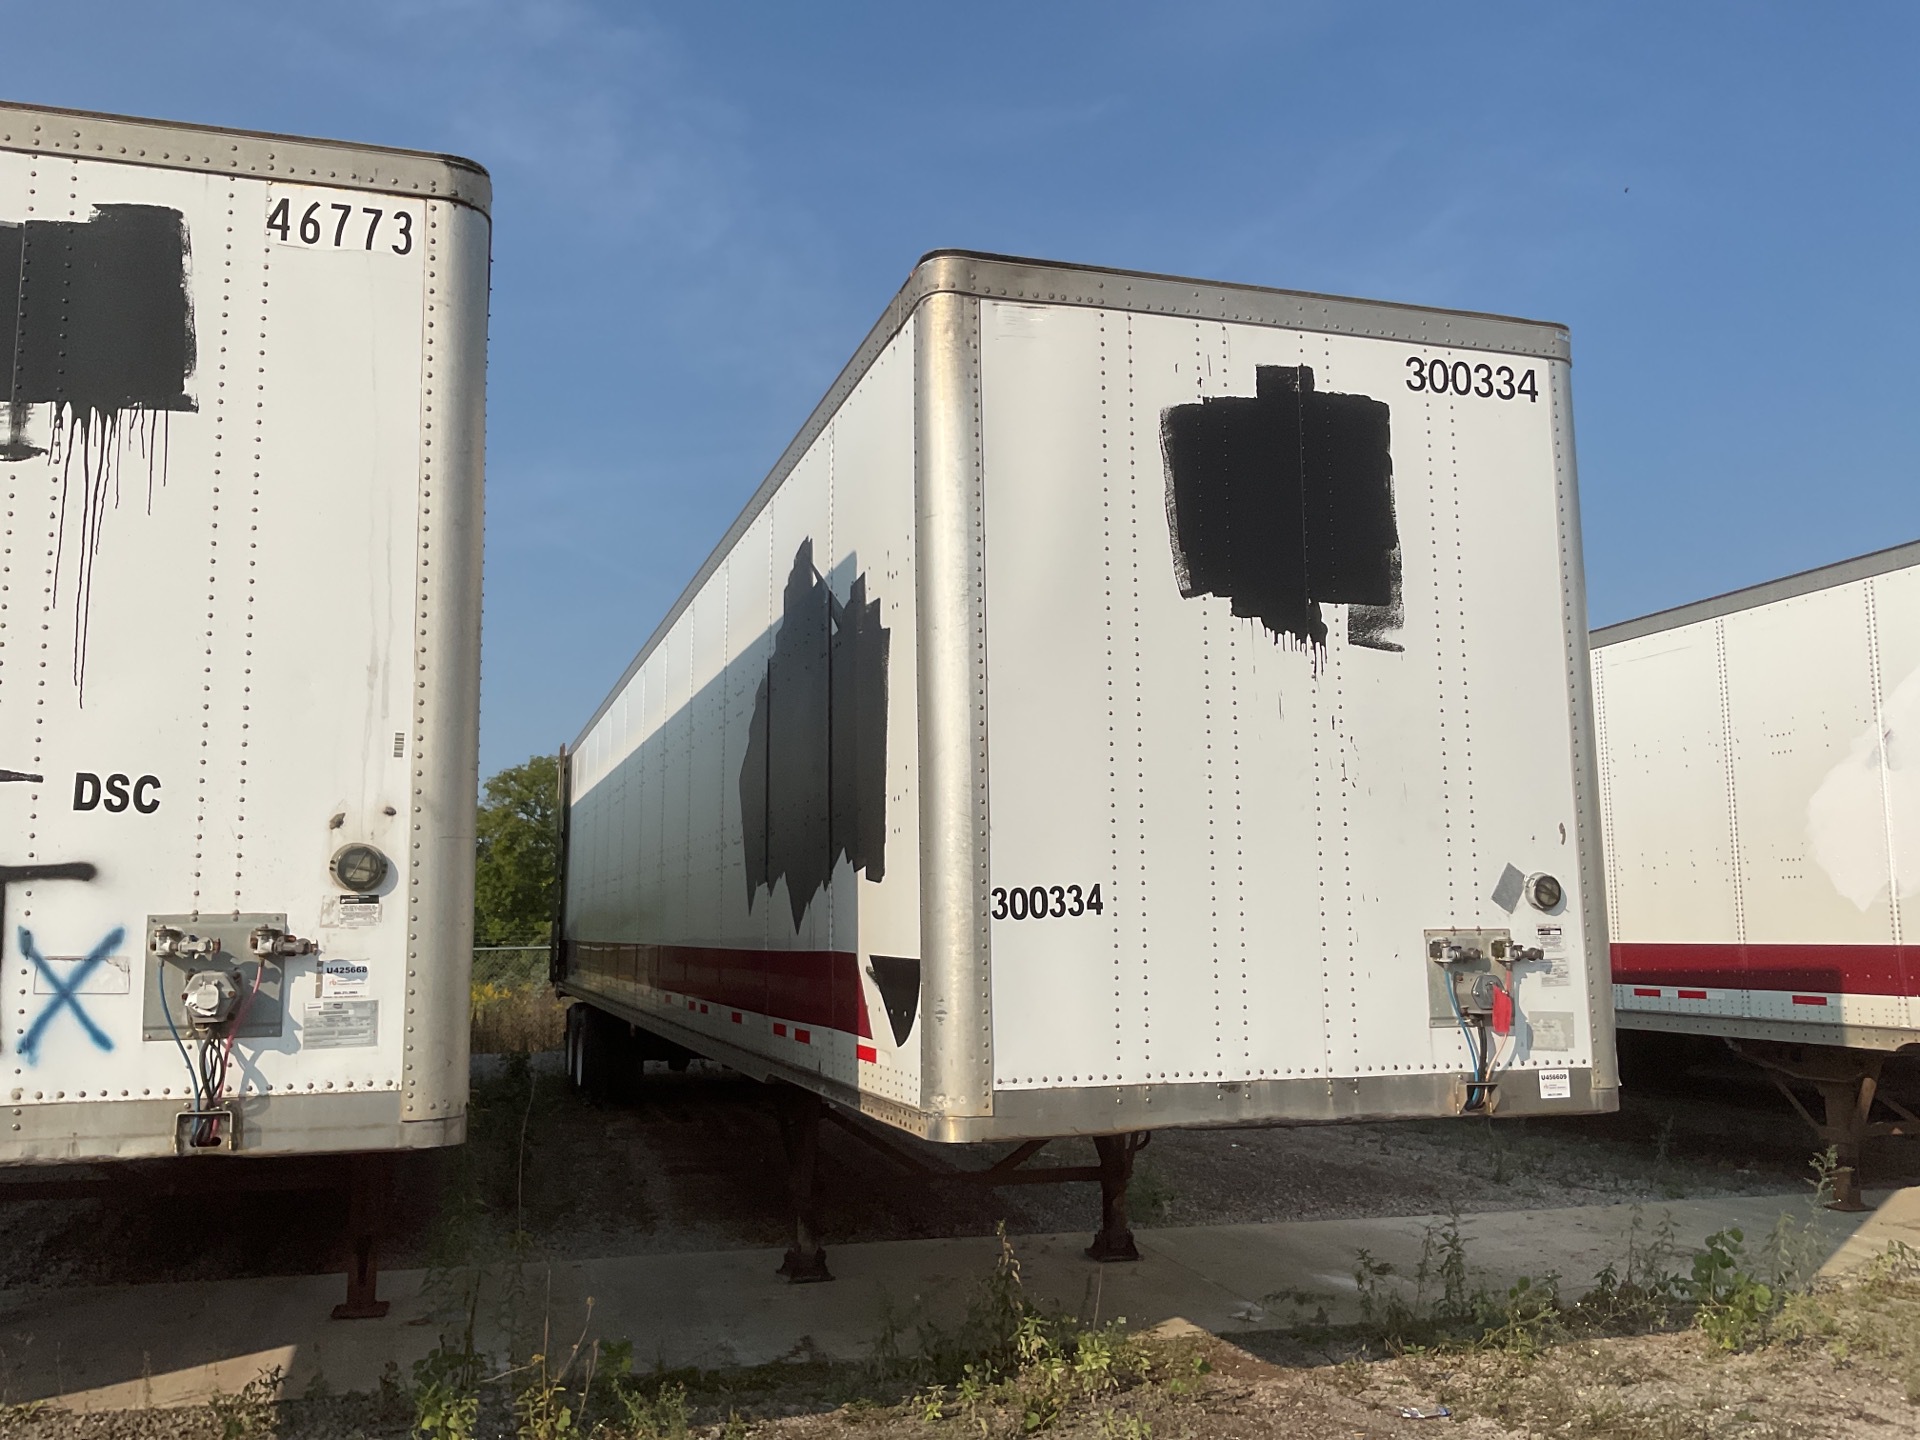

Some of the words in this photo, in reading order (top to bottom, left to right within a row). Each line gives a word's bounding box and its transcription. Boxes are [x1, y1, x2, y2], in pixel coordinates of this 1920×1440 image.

[266, 198, 413, 255] 46773
[1405, 356, 1539, 403] 300334
[73, 772, 162, 814] DSC
[991, 883, 1104, 921] 300334
[326, 965, 368, 974] U425668
